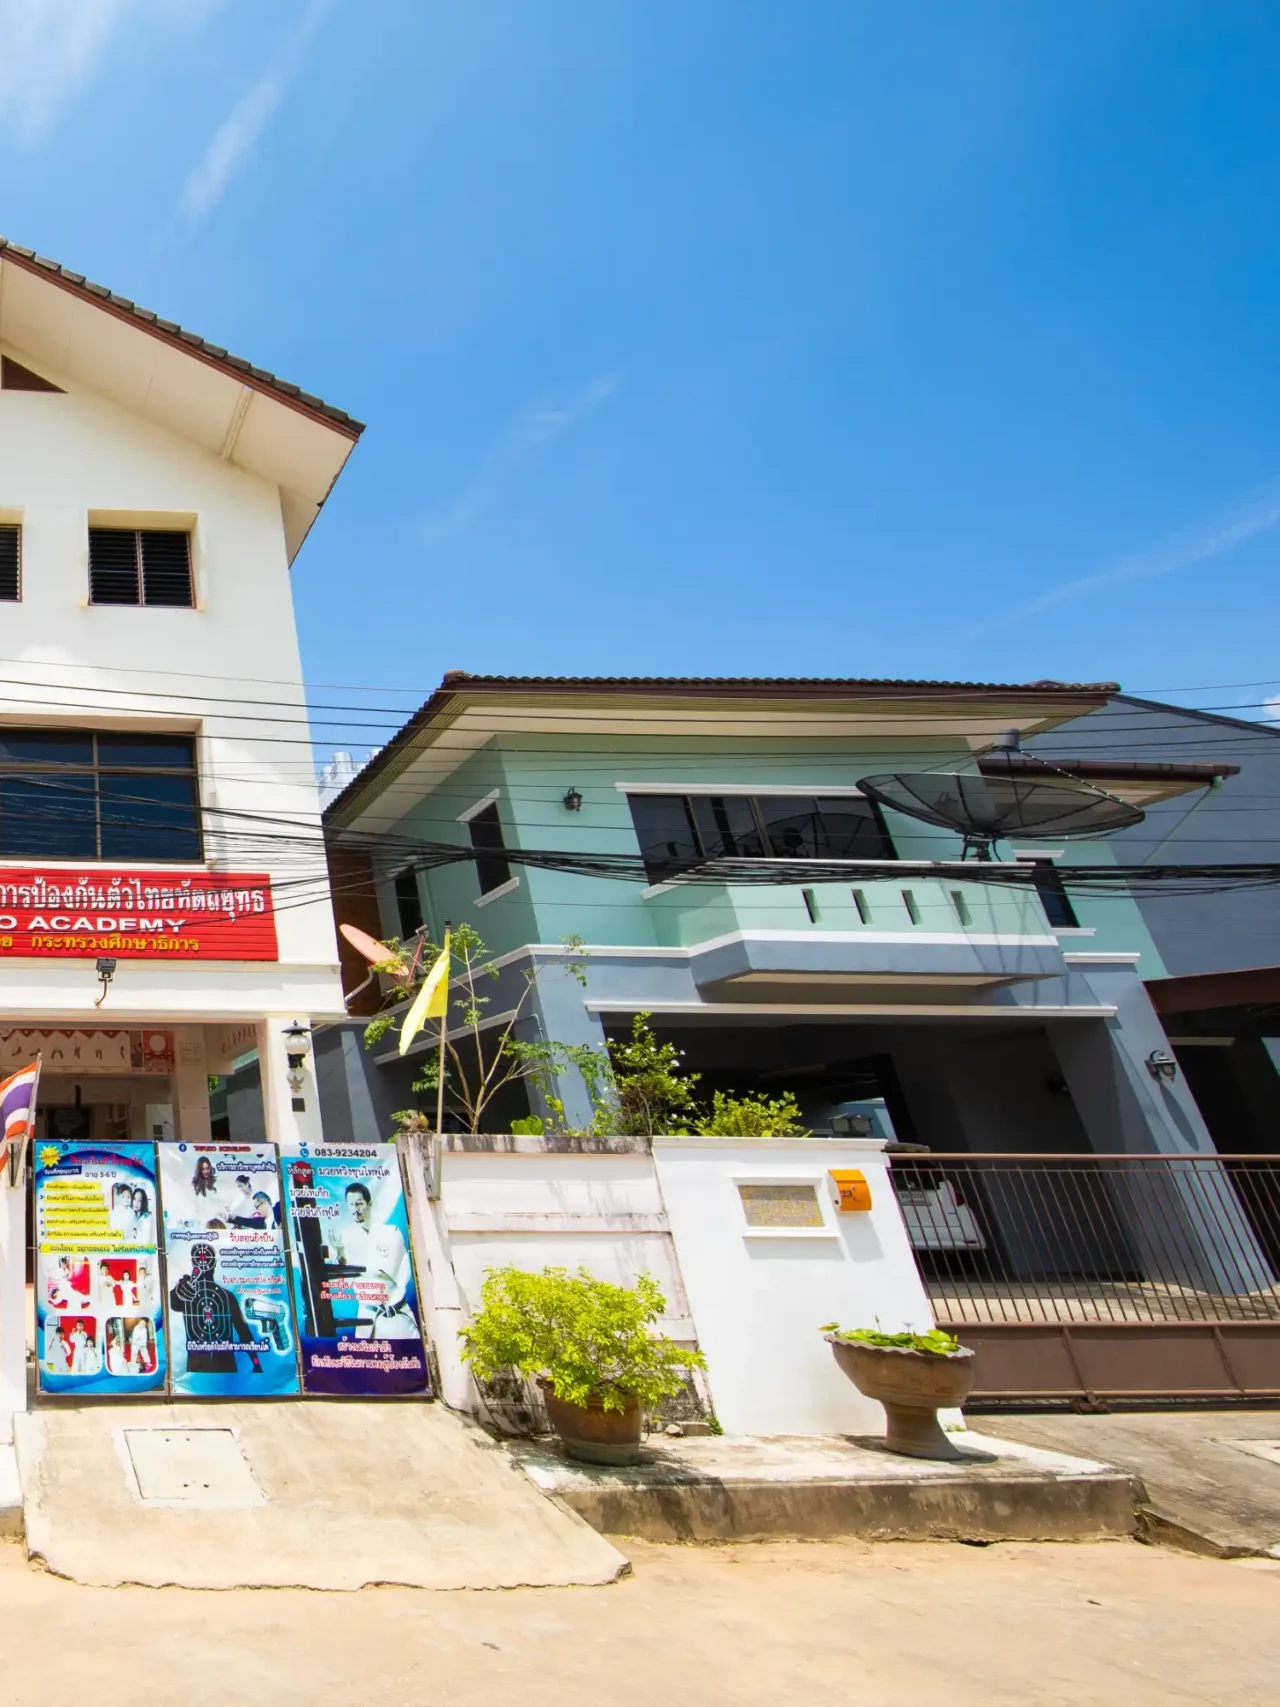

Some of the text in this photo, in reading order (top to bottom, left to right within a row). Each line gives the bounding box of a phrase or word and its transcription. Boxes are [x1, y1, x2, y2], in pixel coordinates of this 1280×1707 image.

[27, 915, 187, 933] ACADEMY
[31, 933, 199, 951] กระทรวงศึกษาธิการ
[315, 1149, 377, 1157] 083-9234204
